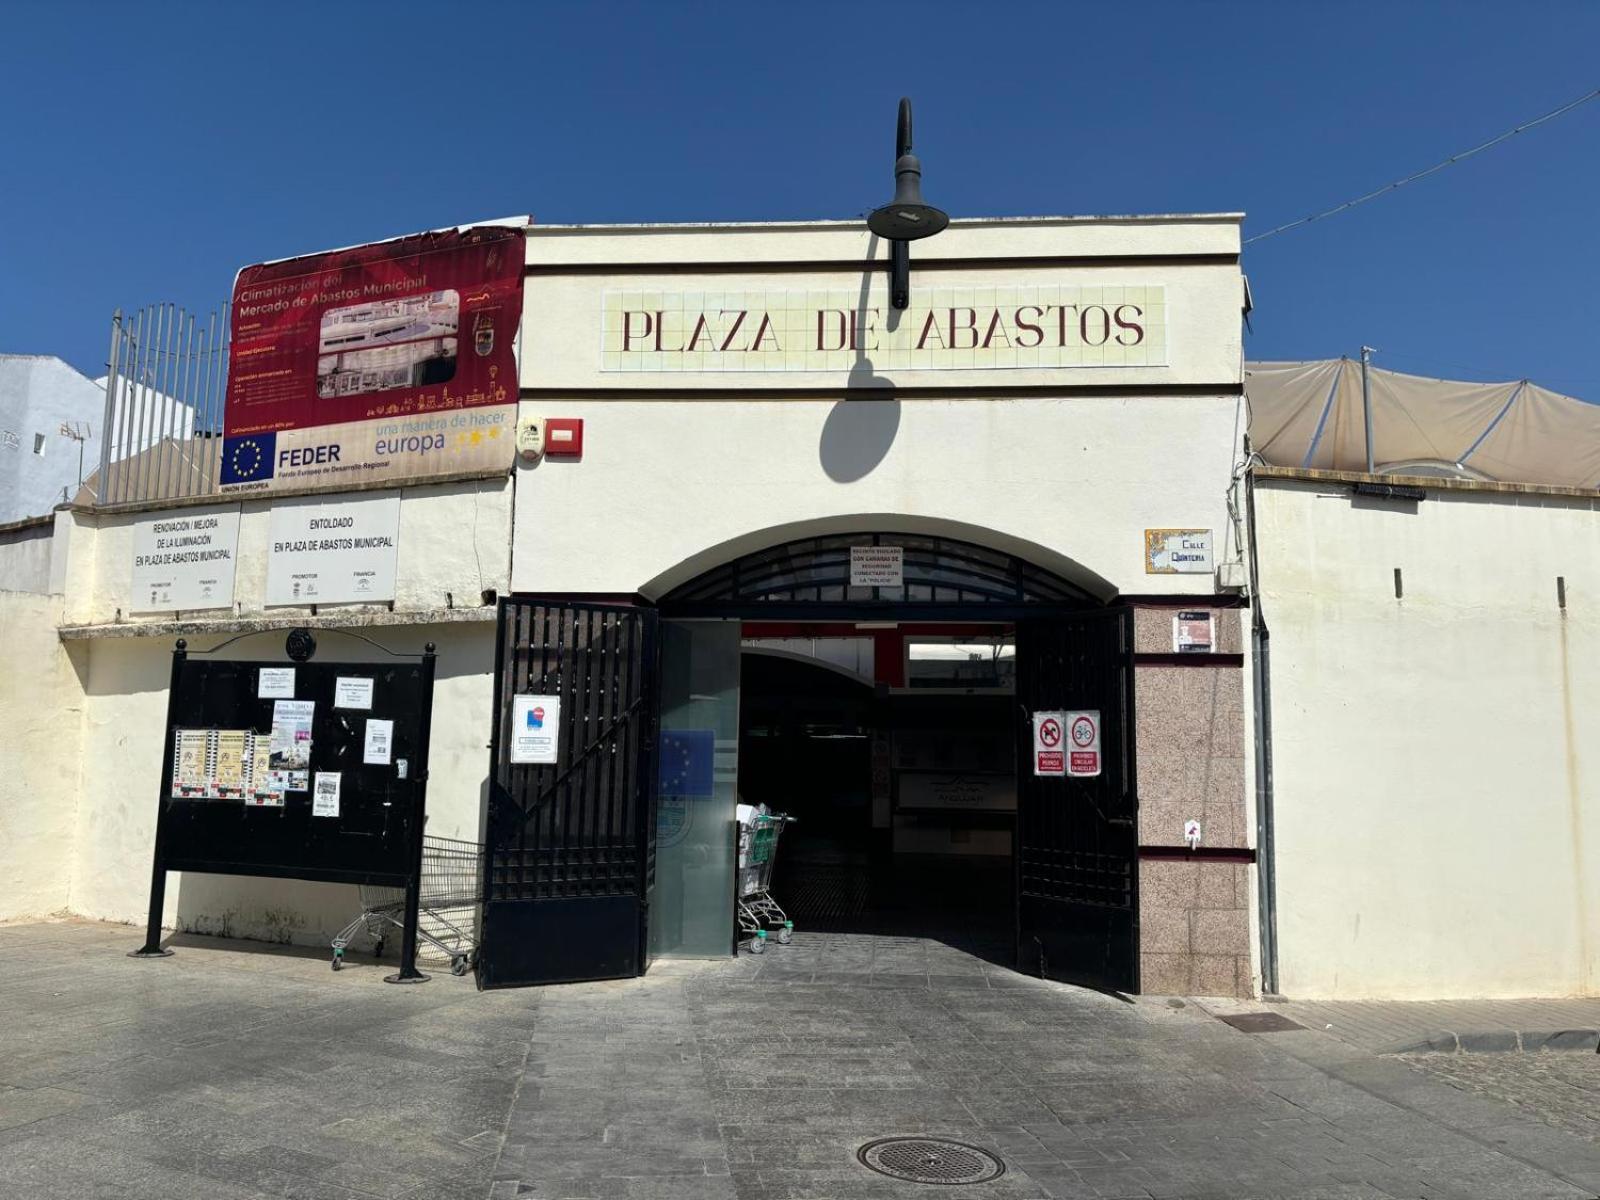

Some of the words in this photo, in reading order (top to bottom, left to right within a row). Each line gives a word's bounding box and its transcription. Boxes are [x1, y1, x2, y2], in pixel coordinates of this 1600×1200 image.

[240, 300, 289, 318] Mercado
[292, 296, 306, 308] de
[310, 289, 360, 305] Abastos
[363, 275, 427, 296] Municipal
[622, 310, 783, 352] PLAZA
[816, 307, 880, 352] DE
[916, 303, 1145, 351] ABASTOS
[376, 424, 398, 436] una
[402, 420, 447, 433] manera
[450, 414, 467, 427] de
[470, 411, 506, 426] hacer
[375, 433, 445, 456] europa
[279, 444, 341, 468] FEDER
[278, 470, 296, 478] Fondo
[297, 468, 321, 478] Europeo
[331, 463, 363, 473] Desarrollo
[363, 460, 390, 470] Regional
[194, 518, 218, 530] MEJORA
[310, 517, 354, 530] ENTOLDADO
[157, 539, 165, 549] DE
[166, 538, 174, 548] LA
[274, 542, 284, 552] EN
[285, 541, 307, 552] PLAZA
[308, 540, 318, 551] DE
[319, 538, 353, 550] ABASTOS
[354, 536, 393, 549] MUNICIPAL
[136, 555, 144, 567] EN
[145, 555, 163, 566] PLAZA
[164, 554, 172, 564] DE
[172, 551, 199, 564] ABASTOS
[200, 549, 231, 562] MUNICIPAL
